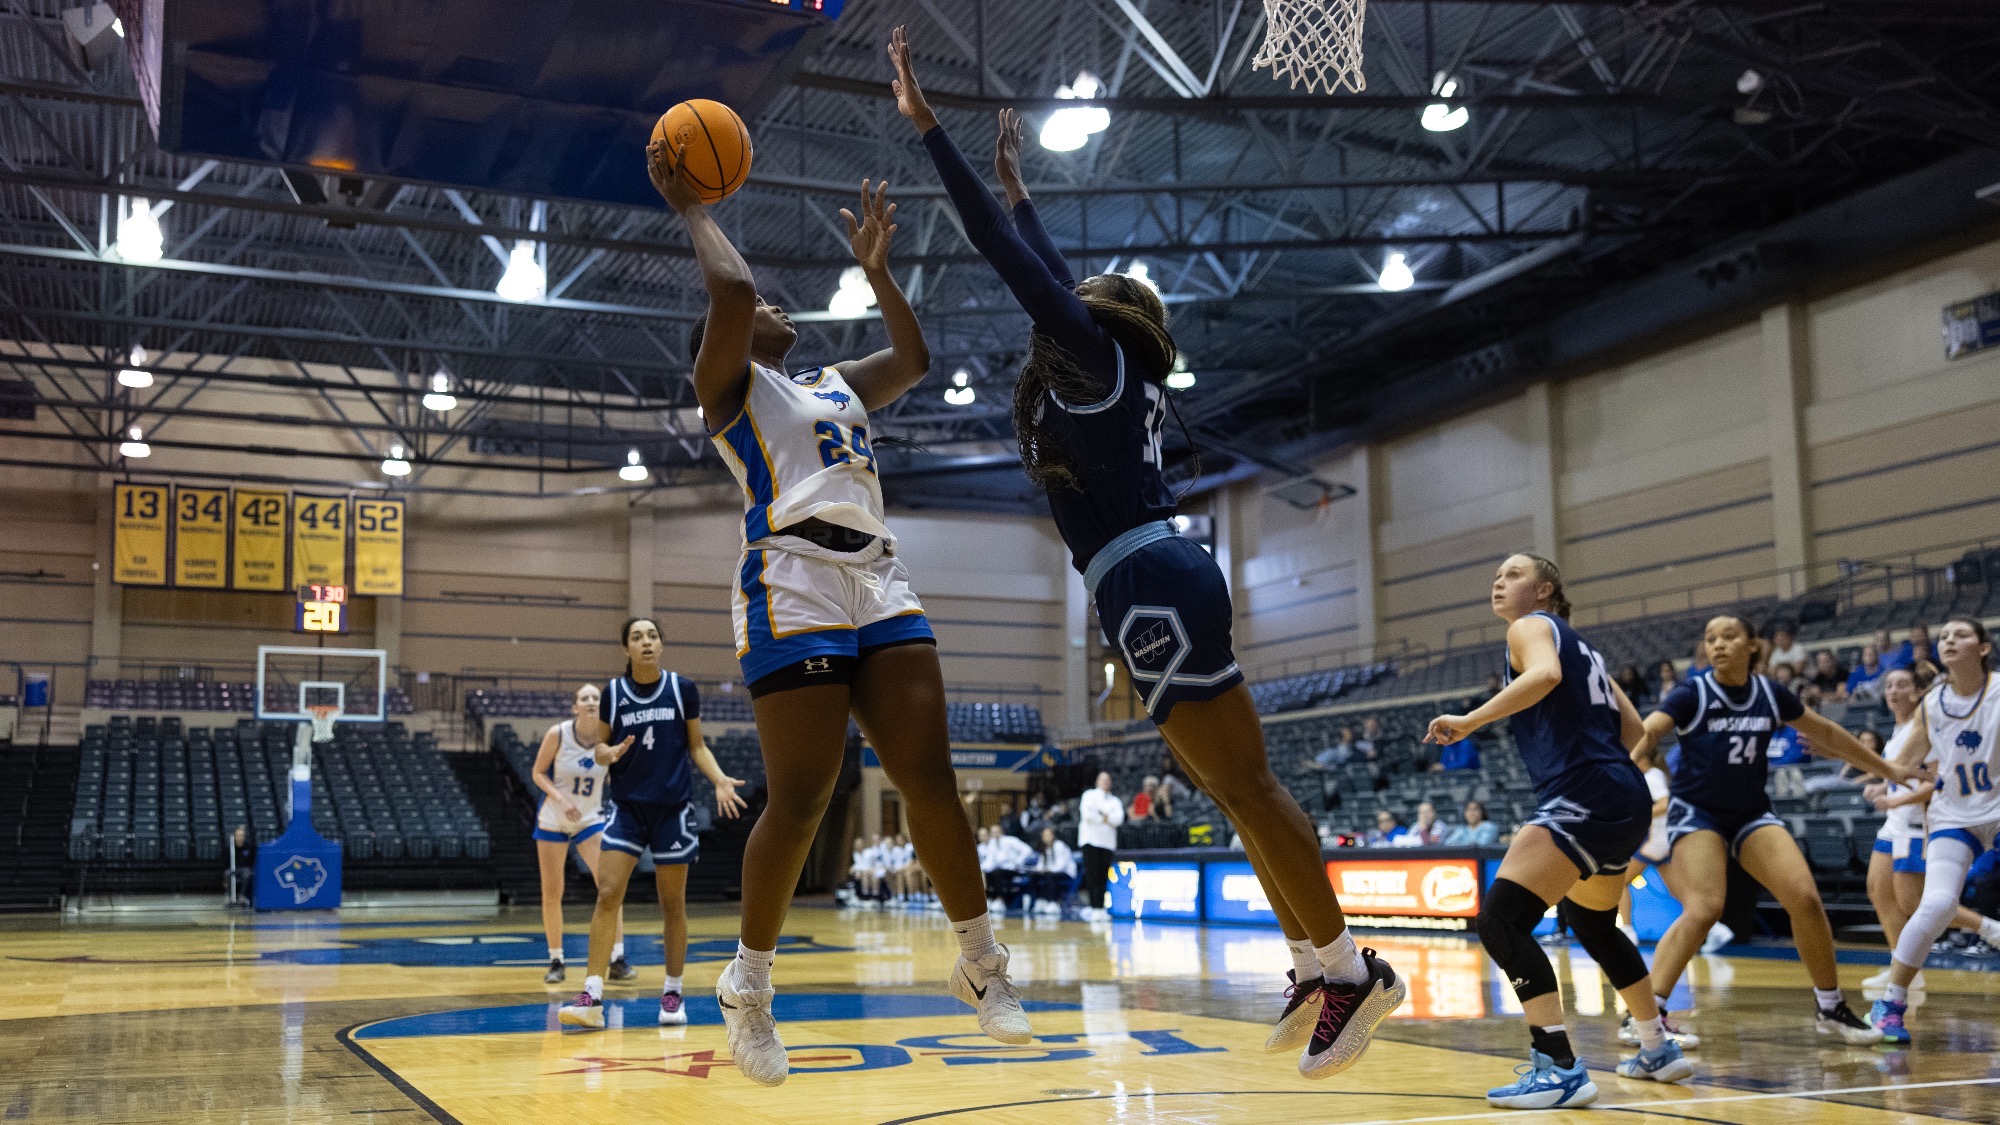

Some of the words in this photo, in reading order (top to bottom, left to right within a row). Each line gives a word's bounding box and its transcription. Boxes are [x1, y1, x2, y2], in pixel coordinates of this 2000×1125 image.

[813, 418, 876, 477] 24
[124, 490, 159, 518] 13
[181, 494, 222, 522] 34
[242, 499, 280, 526] 42
[300, 502, 341, 529] 44
[360, 505, 398, 532] 52
[304, 602, 339, 631] 20
[1133, 634, 1171, 659] WASHBURN
[621, 707, 675, 727] WASHBURN
[1707, 717, 1772, 732] WASHBURN
[642, 726, 656, 750] 4
[1728, 736, 1757, 765] 24
[572, 777, 594, 797] 13
[1955, 762, 1992, 797] 10
